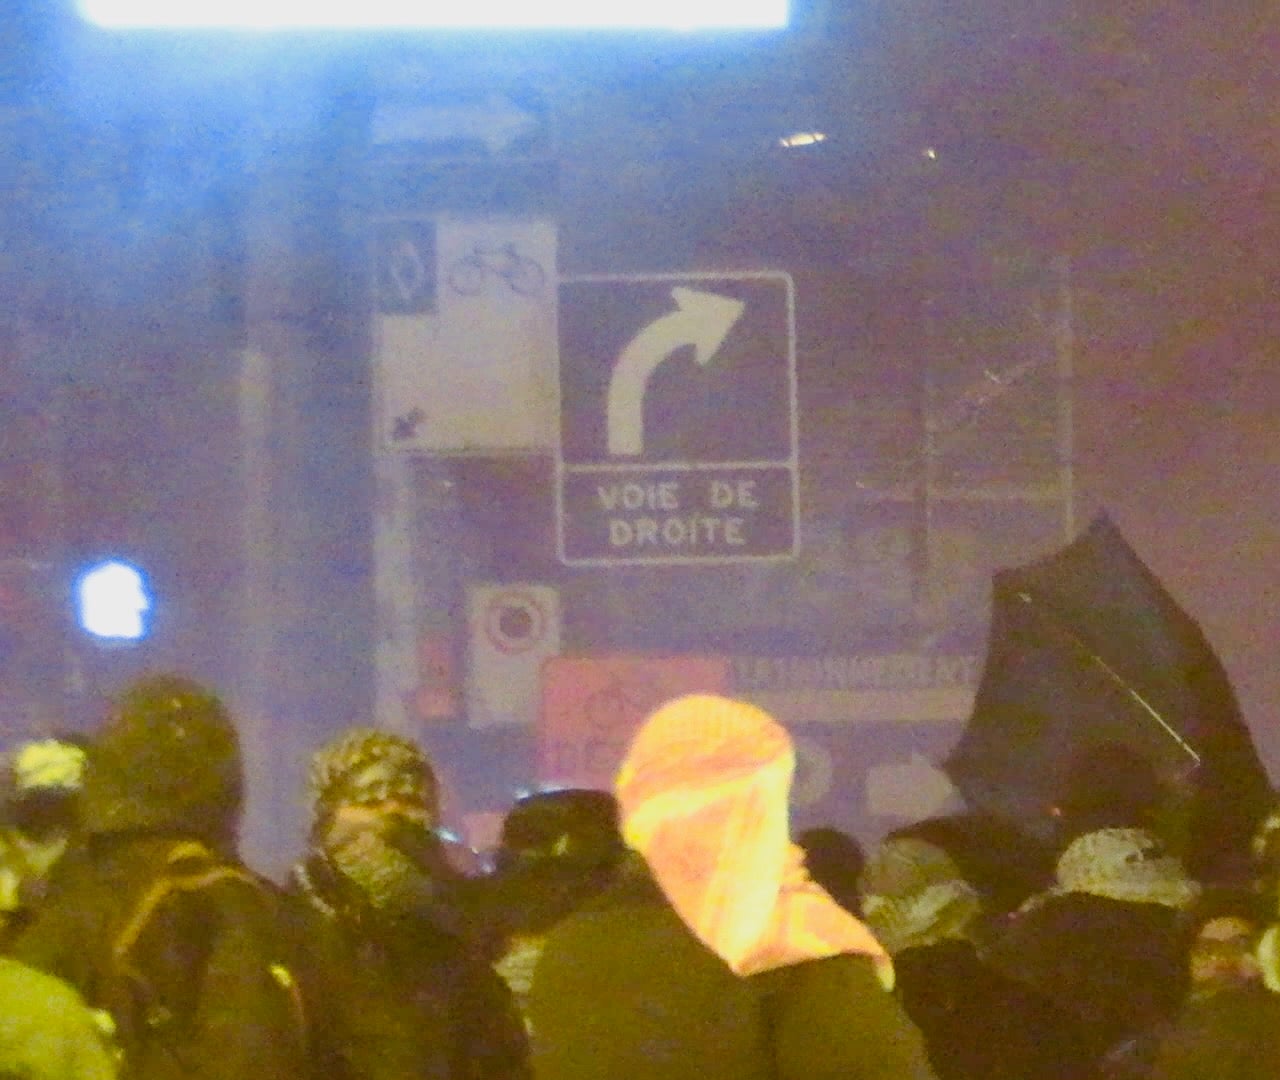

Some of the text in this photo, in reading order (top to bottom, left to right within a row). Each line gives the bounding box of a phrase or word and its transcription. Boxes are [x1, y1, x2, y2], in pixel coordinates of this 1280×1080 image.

[598, 480, 760, 510] VOIE DE
[609, 517, 746, 546] DROITE
